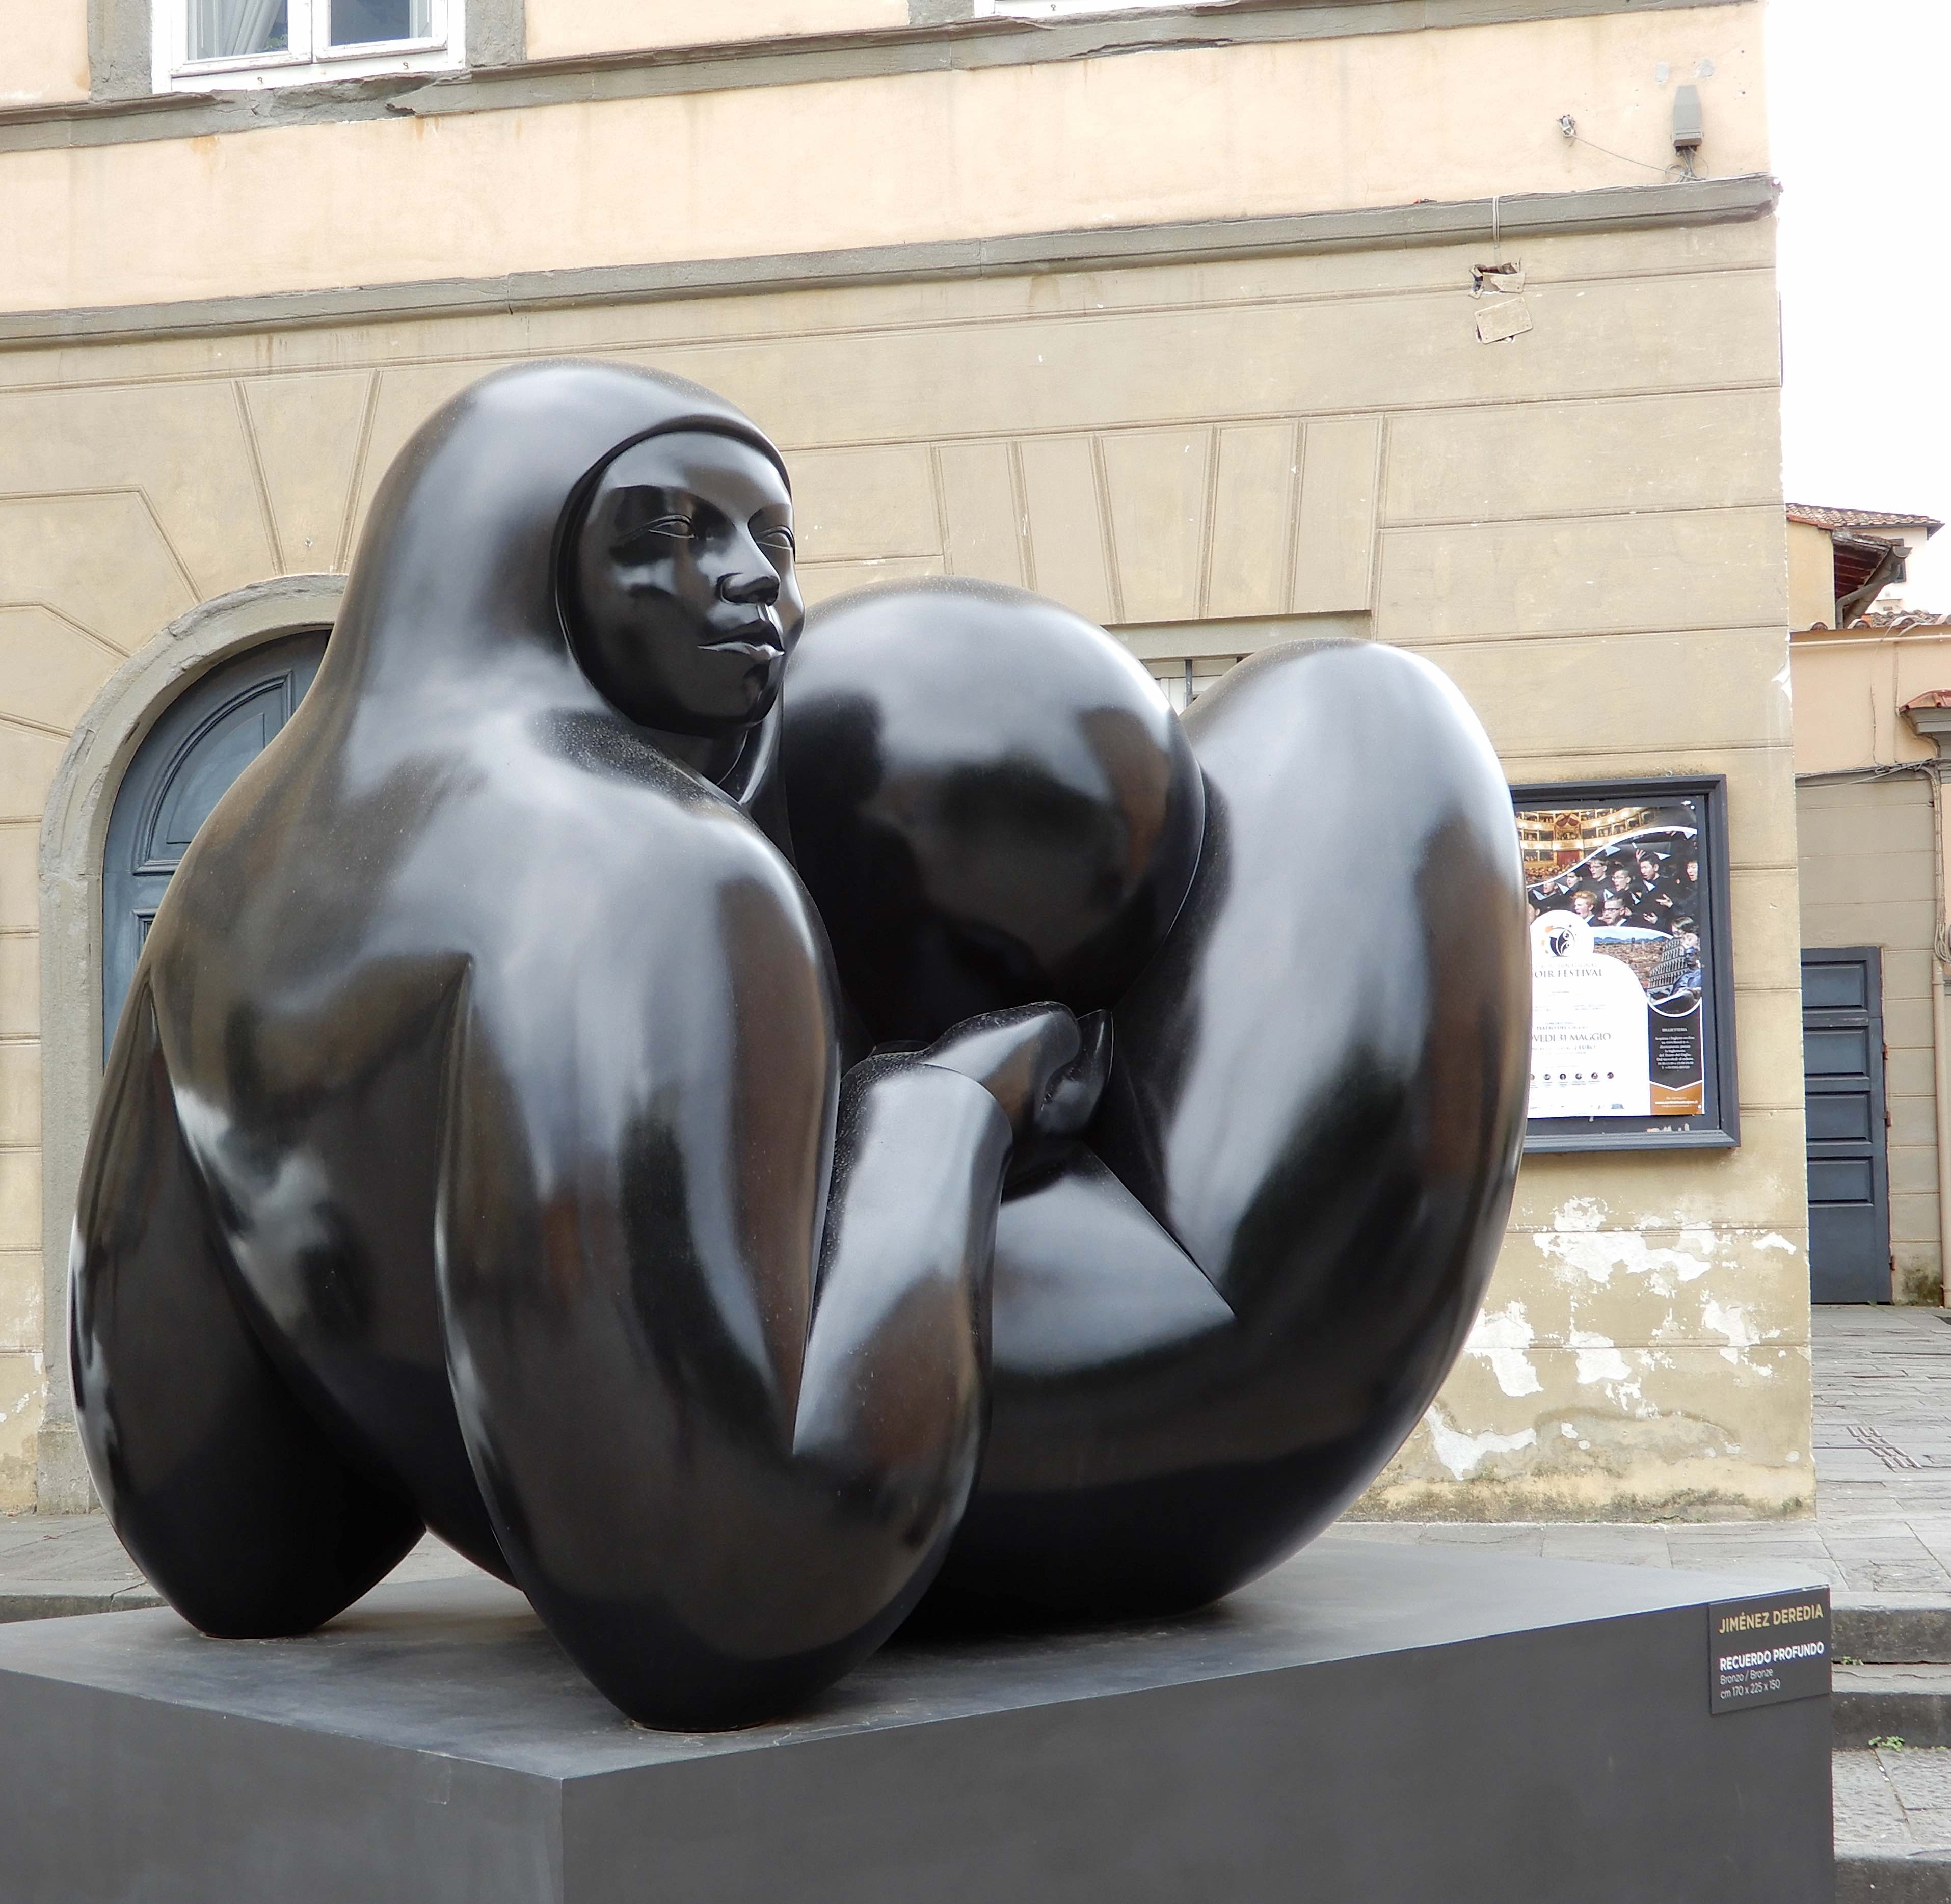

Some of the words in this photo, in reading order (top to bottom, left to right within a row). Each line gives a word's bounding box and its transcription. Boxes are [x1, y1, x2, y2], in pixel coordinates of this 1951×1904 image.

[1558, 969, 1602, 977] FESTIVAL
[1569, 1032, 1611, 1041] MAGGIO
[1719, 1611, 1770, 1634] JIMÉNEZ
[1773, 1604, 1823, 1625] DEREDIA
[1720, 1650, 1771, 1671] RECUERDO
[1773, 1641, 1825, 1661] PROFUNDO
[1720, 1674, 1744, 1685] Bronzo
[1750, 1668, 1773, 1680] Bronze
[1720, 1690, 1731, 1699] cm
[1732, 1685, 1743, 1697] 170
[1750, 1682, 1763, 1694] 225
[1769, 1679, 1781, 1690] 150
